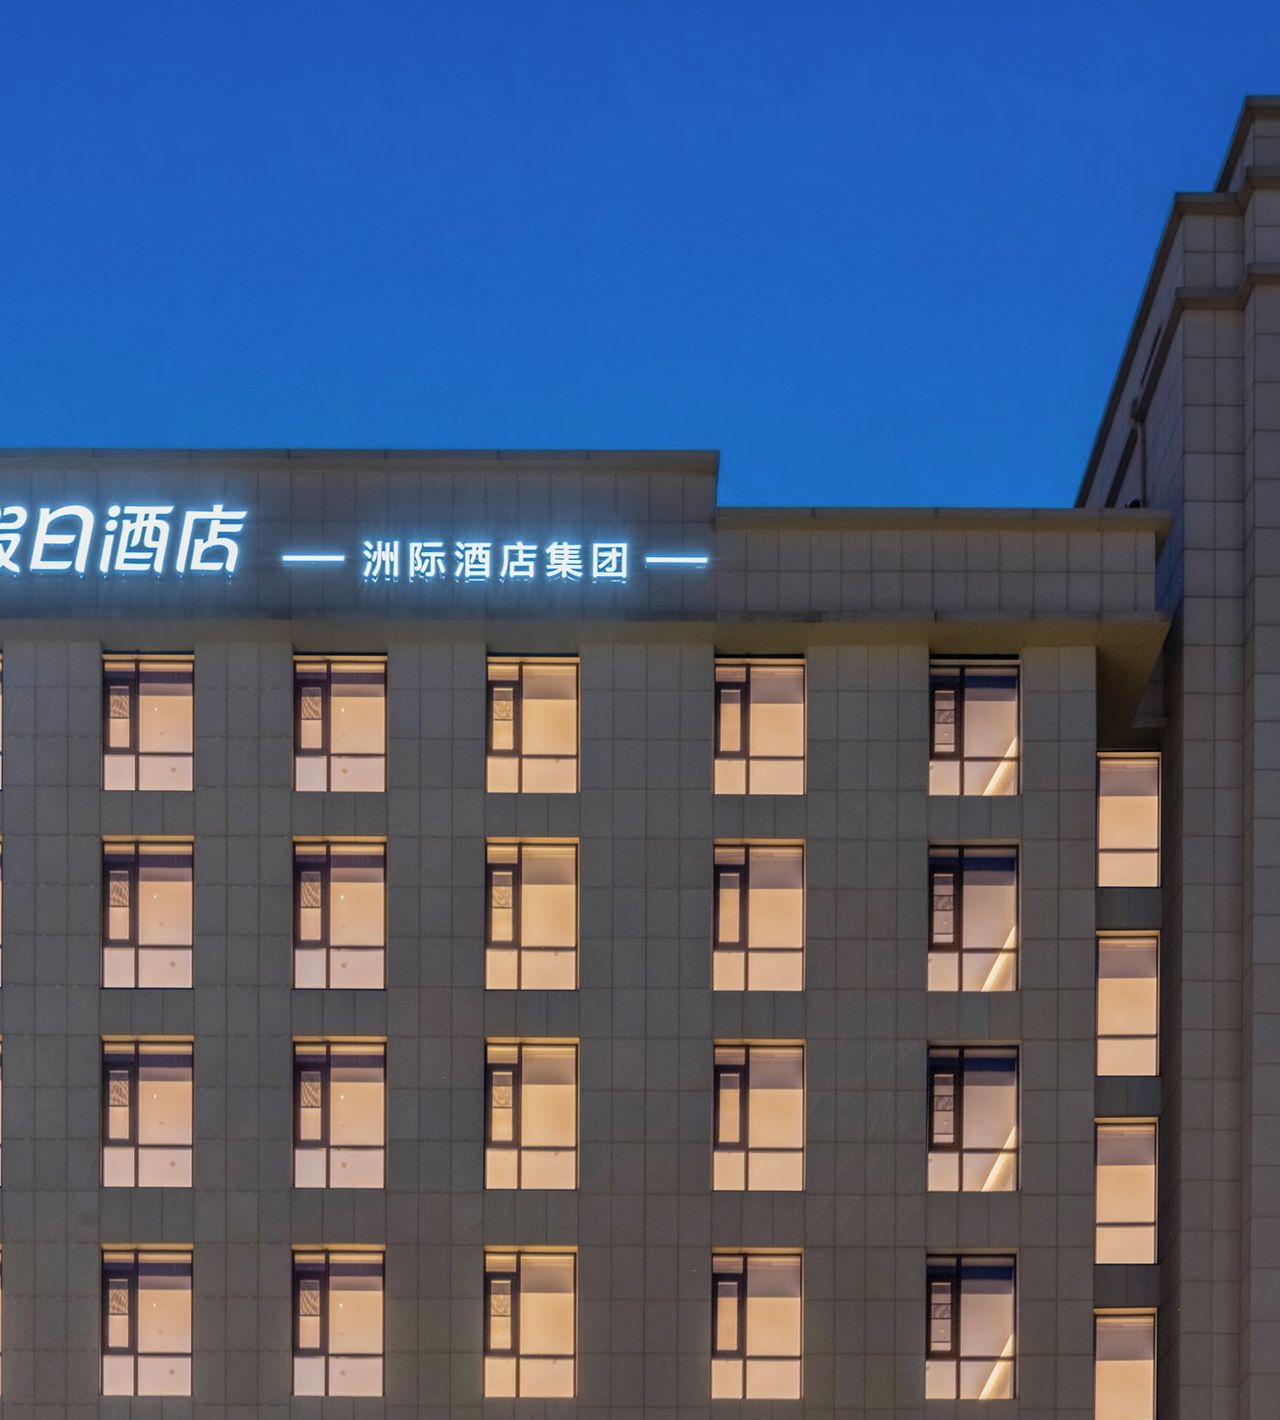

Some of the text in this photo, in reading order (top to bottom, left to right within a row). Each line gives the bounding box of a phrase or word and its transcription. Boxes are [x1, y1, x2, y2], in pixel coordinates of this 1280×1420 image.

[362, 539, 628, 579] 洲际酒店集团
